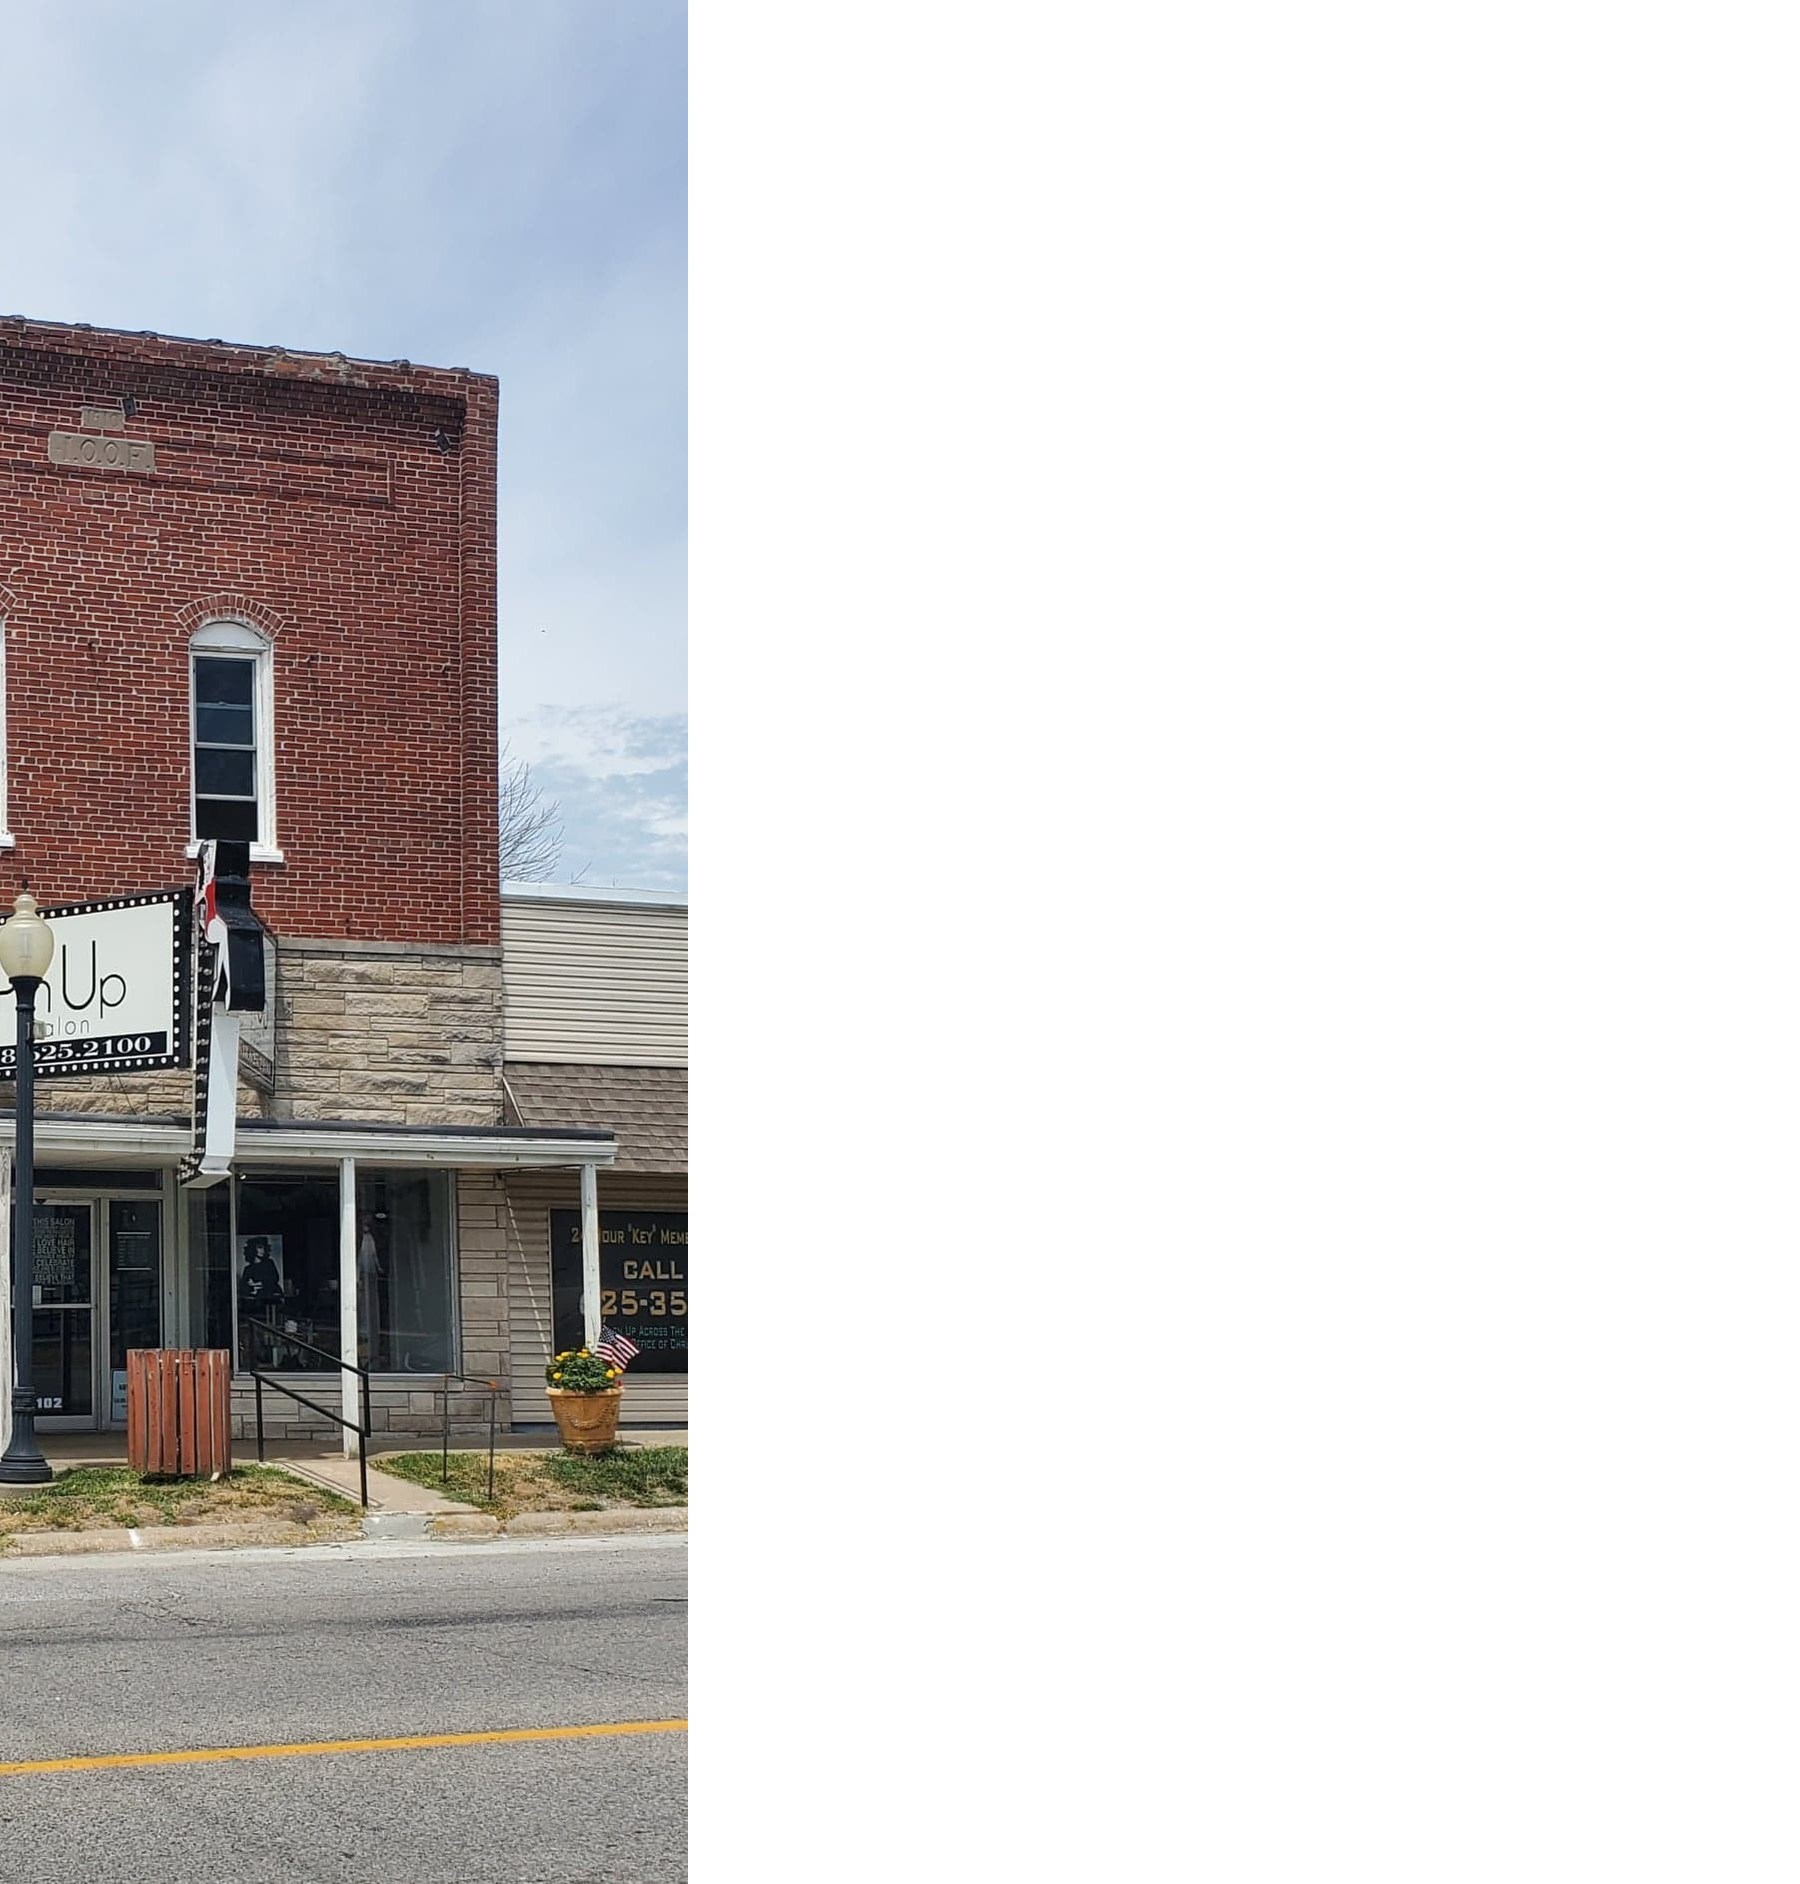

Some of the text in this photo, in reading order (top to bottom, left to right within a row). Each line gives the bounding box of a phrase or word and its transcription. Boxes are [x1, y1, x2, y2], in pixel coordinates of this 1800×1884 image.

[62, 940, 126, 1019] Up
[599, 1229, 625, 1244] OUR
[623, 1260, 684, 1280] CALL
[580, 1290, 688, 1316] 25-35
[36, 1397, 63, 1409] 102
